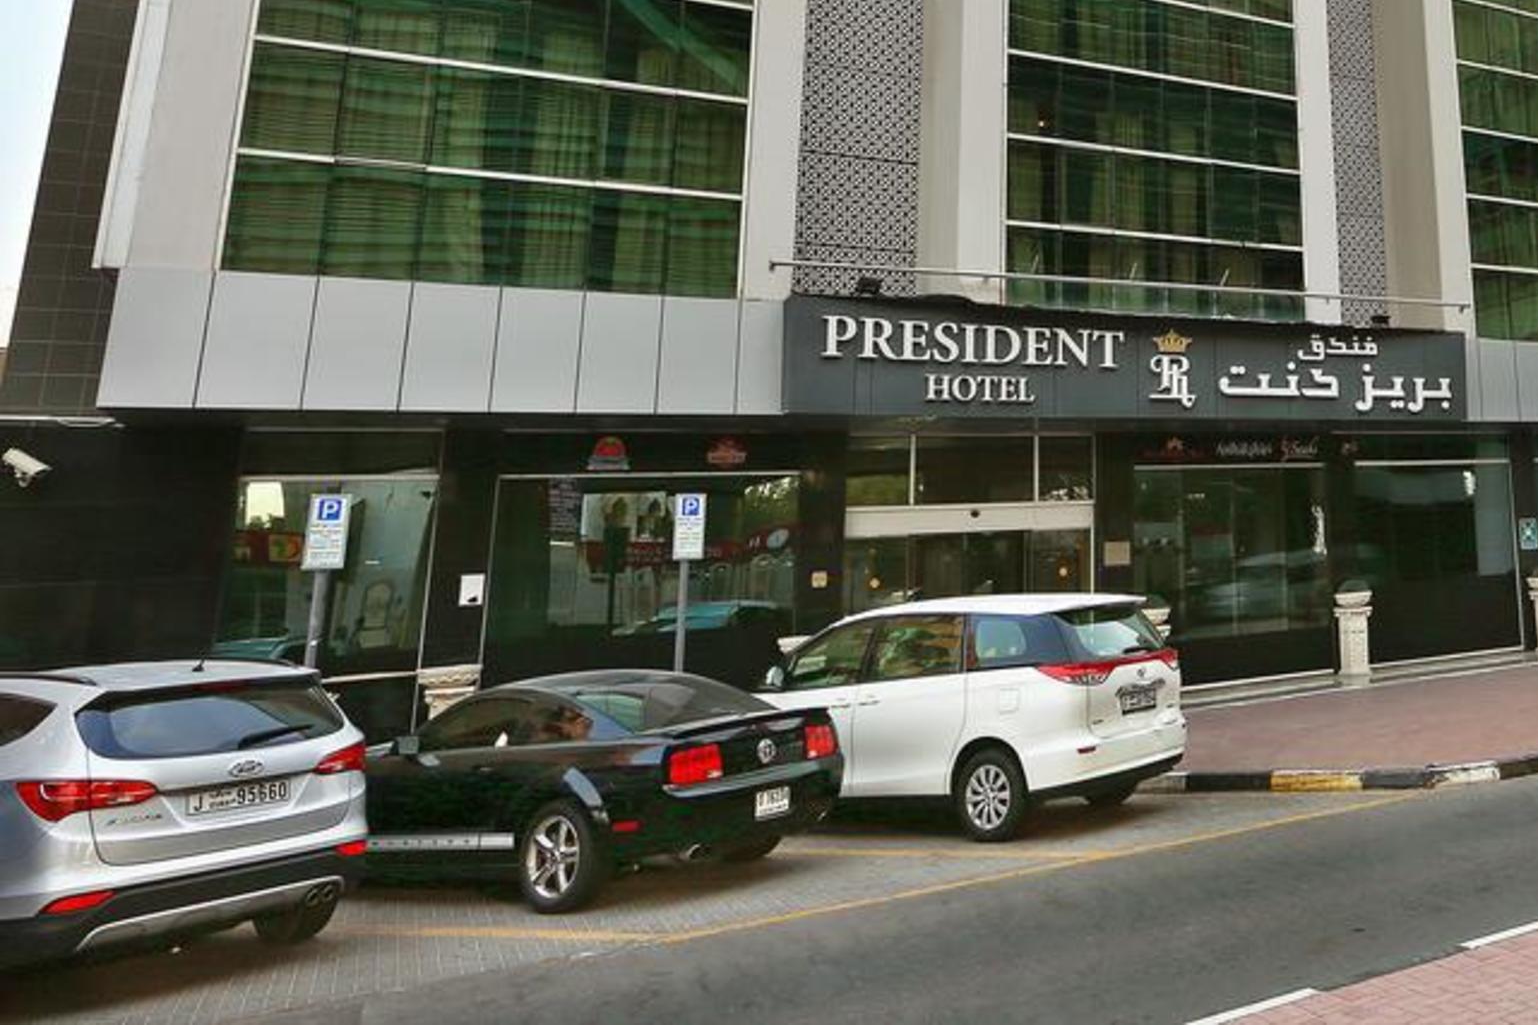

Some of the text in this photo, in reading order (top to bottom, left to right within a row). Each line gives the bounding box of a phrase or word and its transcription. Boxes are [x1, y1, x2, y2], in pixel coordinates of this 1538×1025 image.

[820, 314, 1125, 369] PRESIDENT
[1297, 334, 1378, 361] فندق
[924, 373, 1036, 402] HOTEL
[321, 500, 340, 520] P
[193, 796, 203, 812] J
[236, 781, 287, 804] 95660
